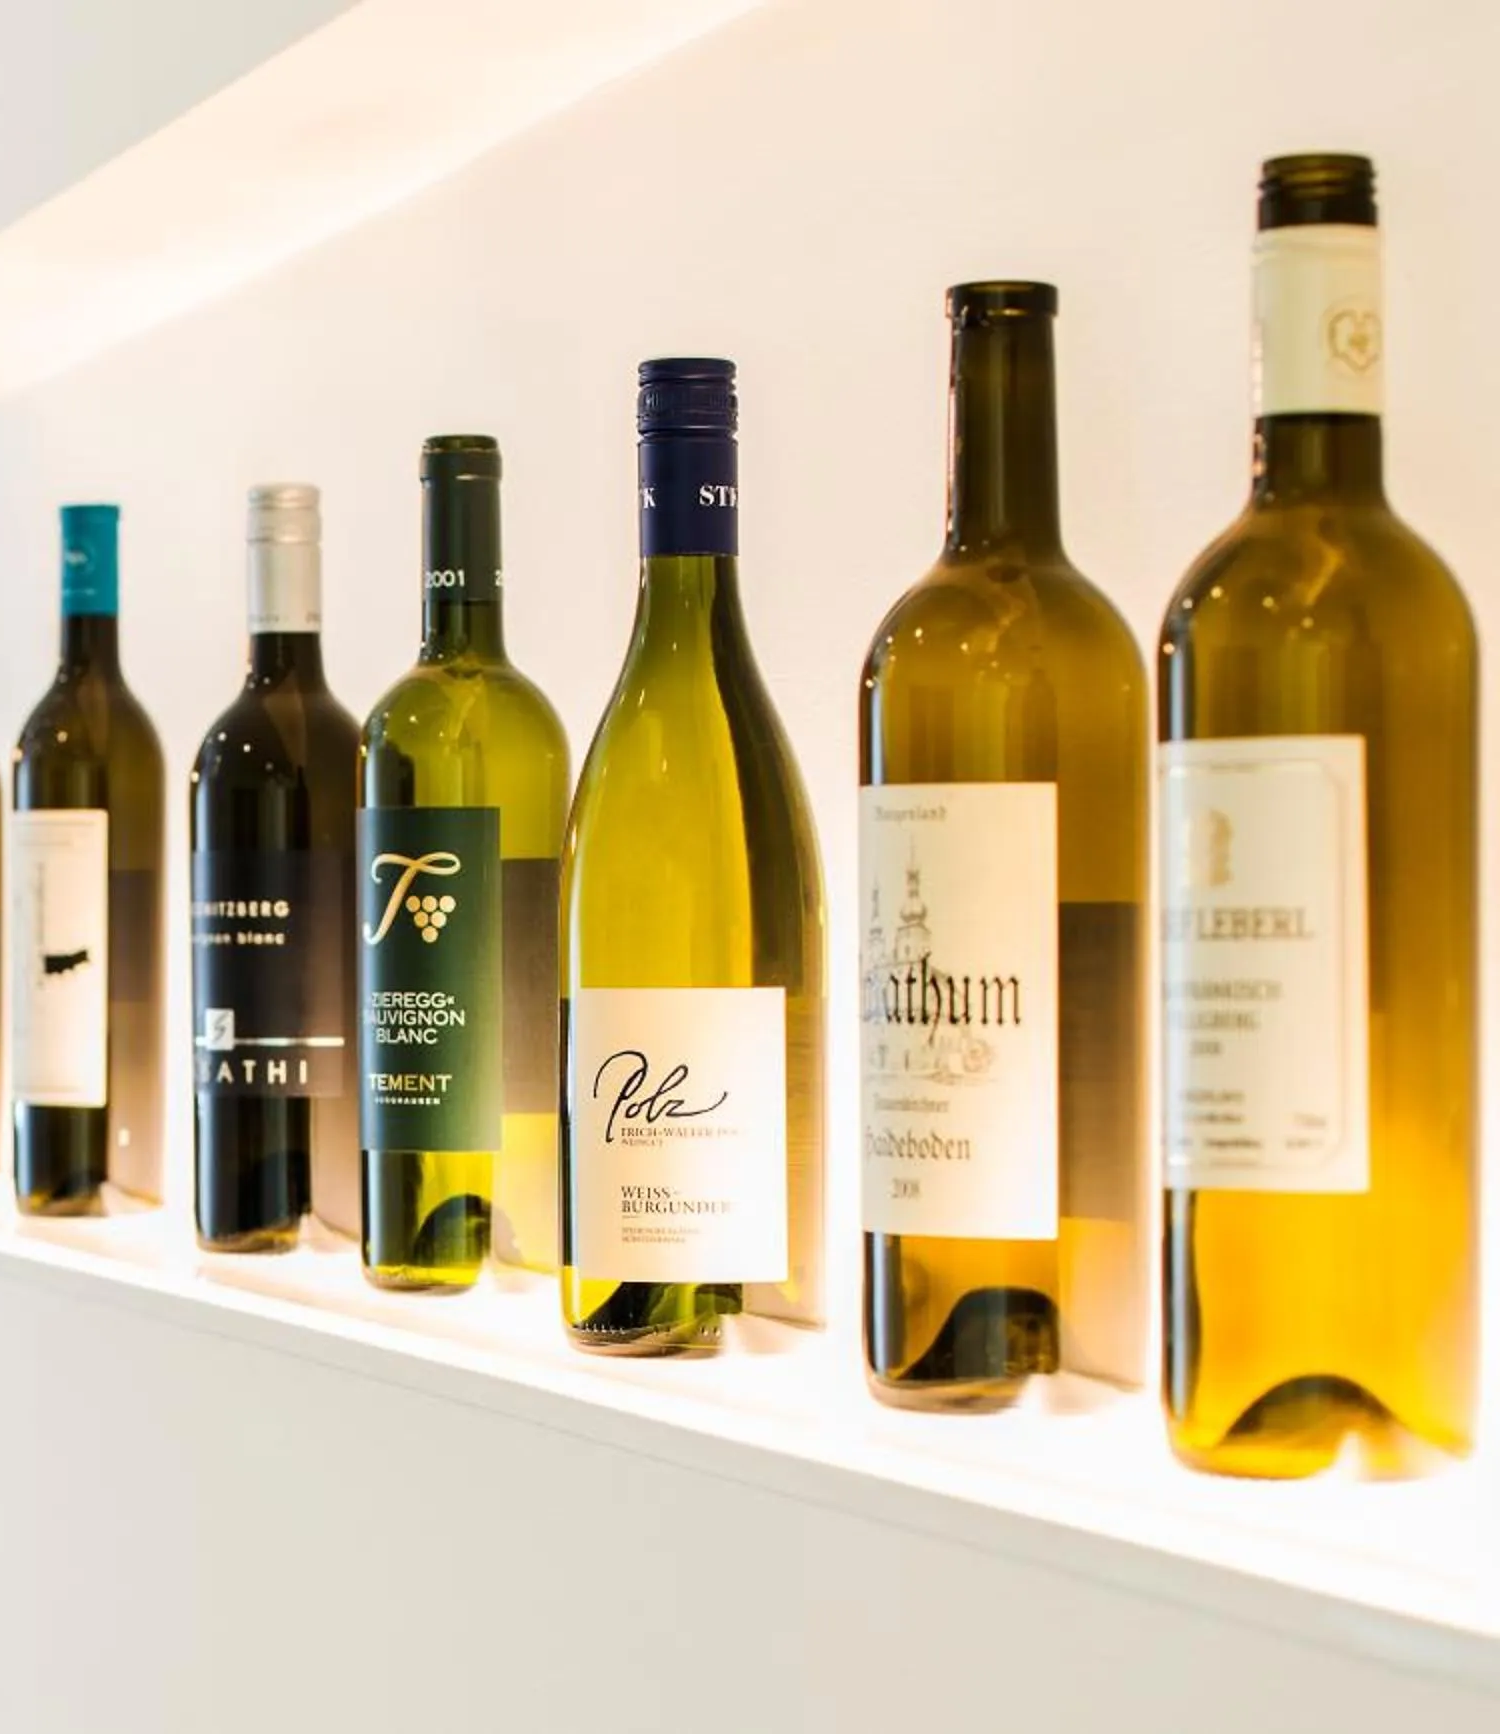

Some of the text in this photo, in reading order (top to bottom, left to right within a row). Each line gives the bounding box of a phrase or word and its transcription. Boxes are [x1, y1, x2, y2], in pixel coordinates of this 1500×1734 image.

[425, 569, 465, 588] 2001
[376, 1028, 439, 1045] BLANC
[368, 1073, 453, 1093] TEMENT
[592, 1050, 728, 1143] Polz
